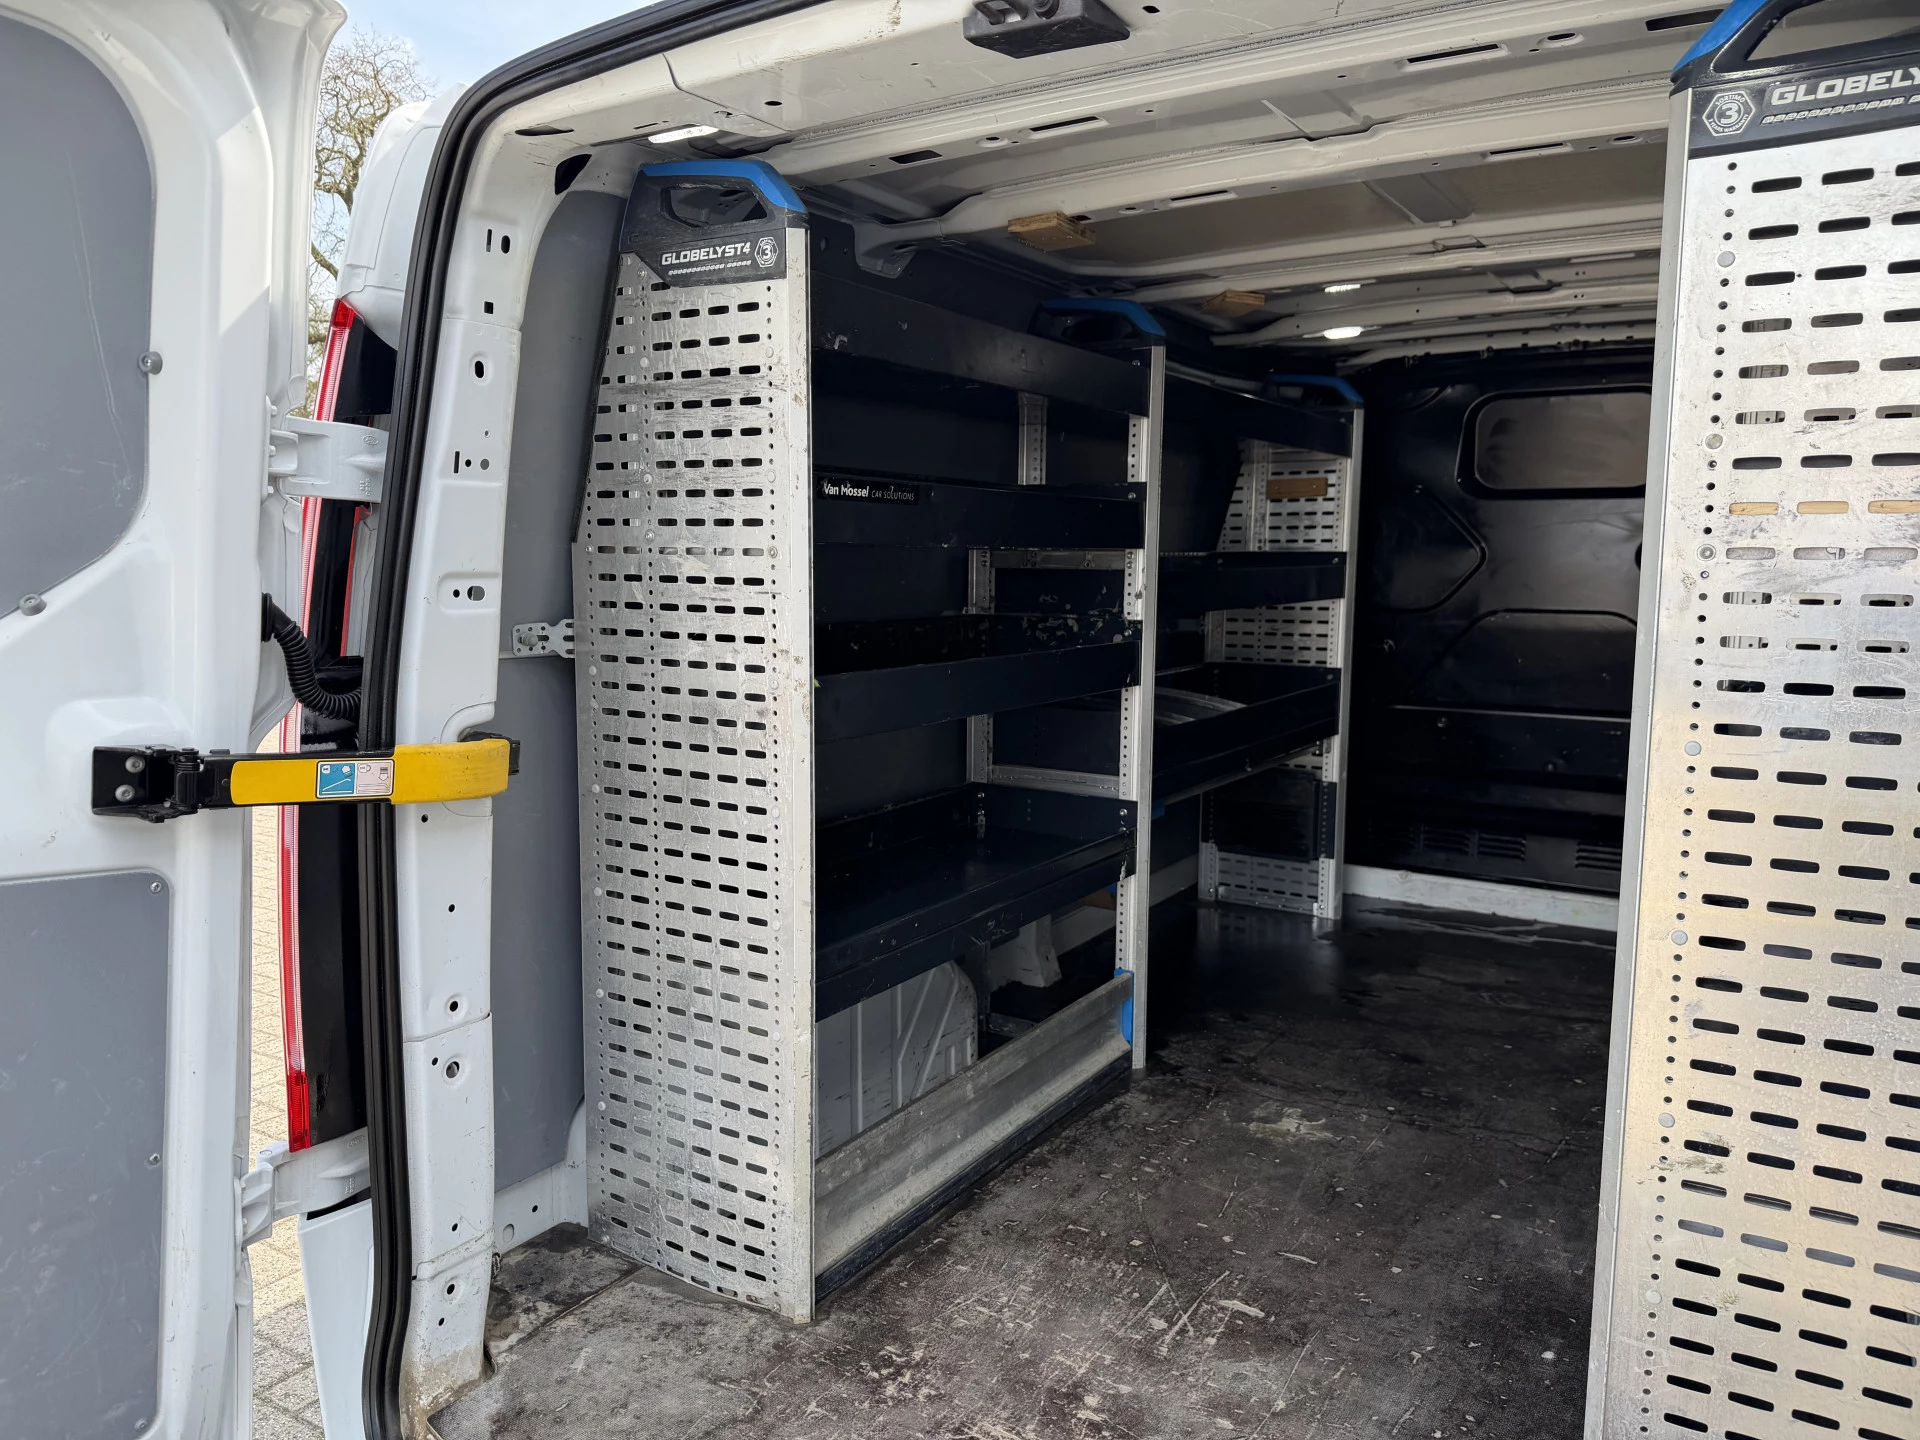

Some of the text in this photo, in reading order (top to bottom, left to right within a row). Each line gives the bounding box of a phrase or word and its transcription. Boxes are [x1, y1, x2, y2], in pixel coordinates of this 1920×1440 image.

[1720, 102, 1739, 124] 3
[661, 241, 751, 266] GLOBELYST4
[762, 245, 772, 259] 3
[823, 482, 915, 501] Van Mossel CAR SOLUTIONS
